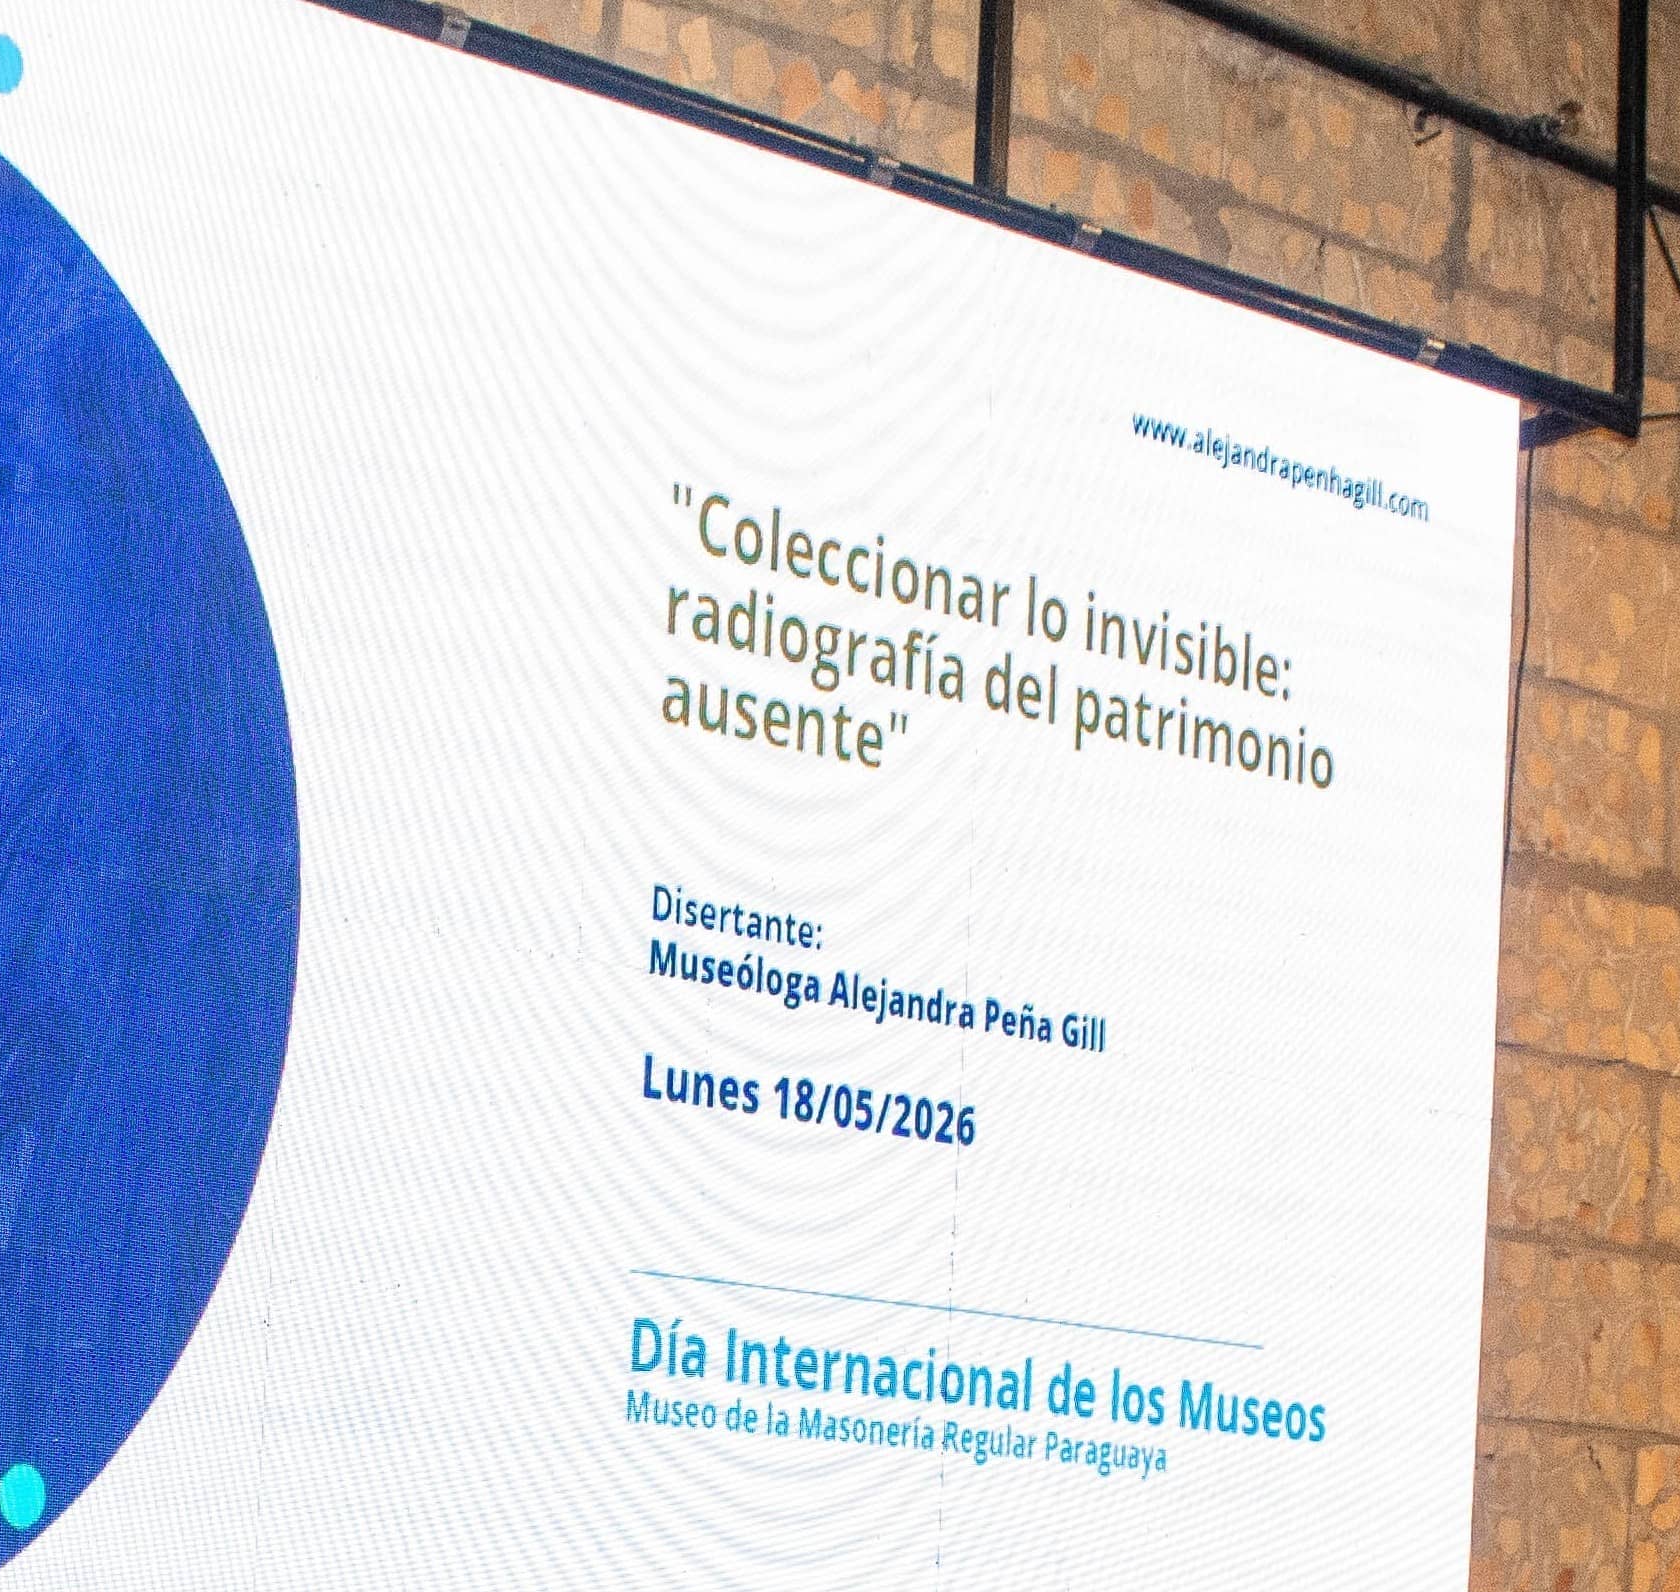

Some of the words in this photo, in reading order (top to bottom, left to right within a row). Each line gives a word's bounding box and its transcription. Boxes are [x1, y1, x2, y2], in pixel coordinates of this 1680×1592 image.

[1132, 411, 1429, 522] www.alejandrapenhagill.com
[672, 482, 1010, 628] "Coleccionar
[1027, 576, 1067, 643] lo
[1085, 591, 1291, 700] invisible:
[662, 677, 909, 768] ausente"
[667, 586, 964, 703] radiografía
[985, 653, 1057, 725] del
[1075, 686, 1333, 790] patrimonio
[652, 884, 822, 951] Disertante:
[648, 938, 822, 1010] Museóloga
[828, 970, 976, 1031] Alejandra
[984, 996, 1053, 1044] Peña
[1061, 1010, 1107, 1053] Gill
[643, 1052, 761, 1116] Lunes
[773, 1075, 977, 1147] 18/05/2026
[625, 1389, 718, 1429] Museo
[724, 1398, 759, 1434] de
[766, 1401, 790, 1438] la
[799, 1407, 935, 1452] Masonería
[942, 1420, 1037, 1466] Regular
[1045, 1430, 1167, 1480] Paraguaya
[630, 1317, 708, 1379] Día
[725, 1327, 1033, 1413] Internacional
[1047, 1361, 1097, 1419] de
[1111, 1367, 1166, 1427] los
[1179, 1379, 1327, 1443] Museos
